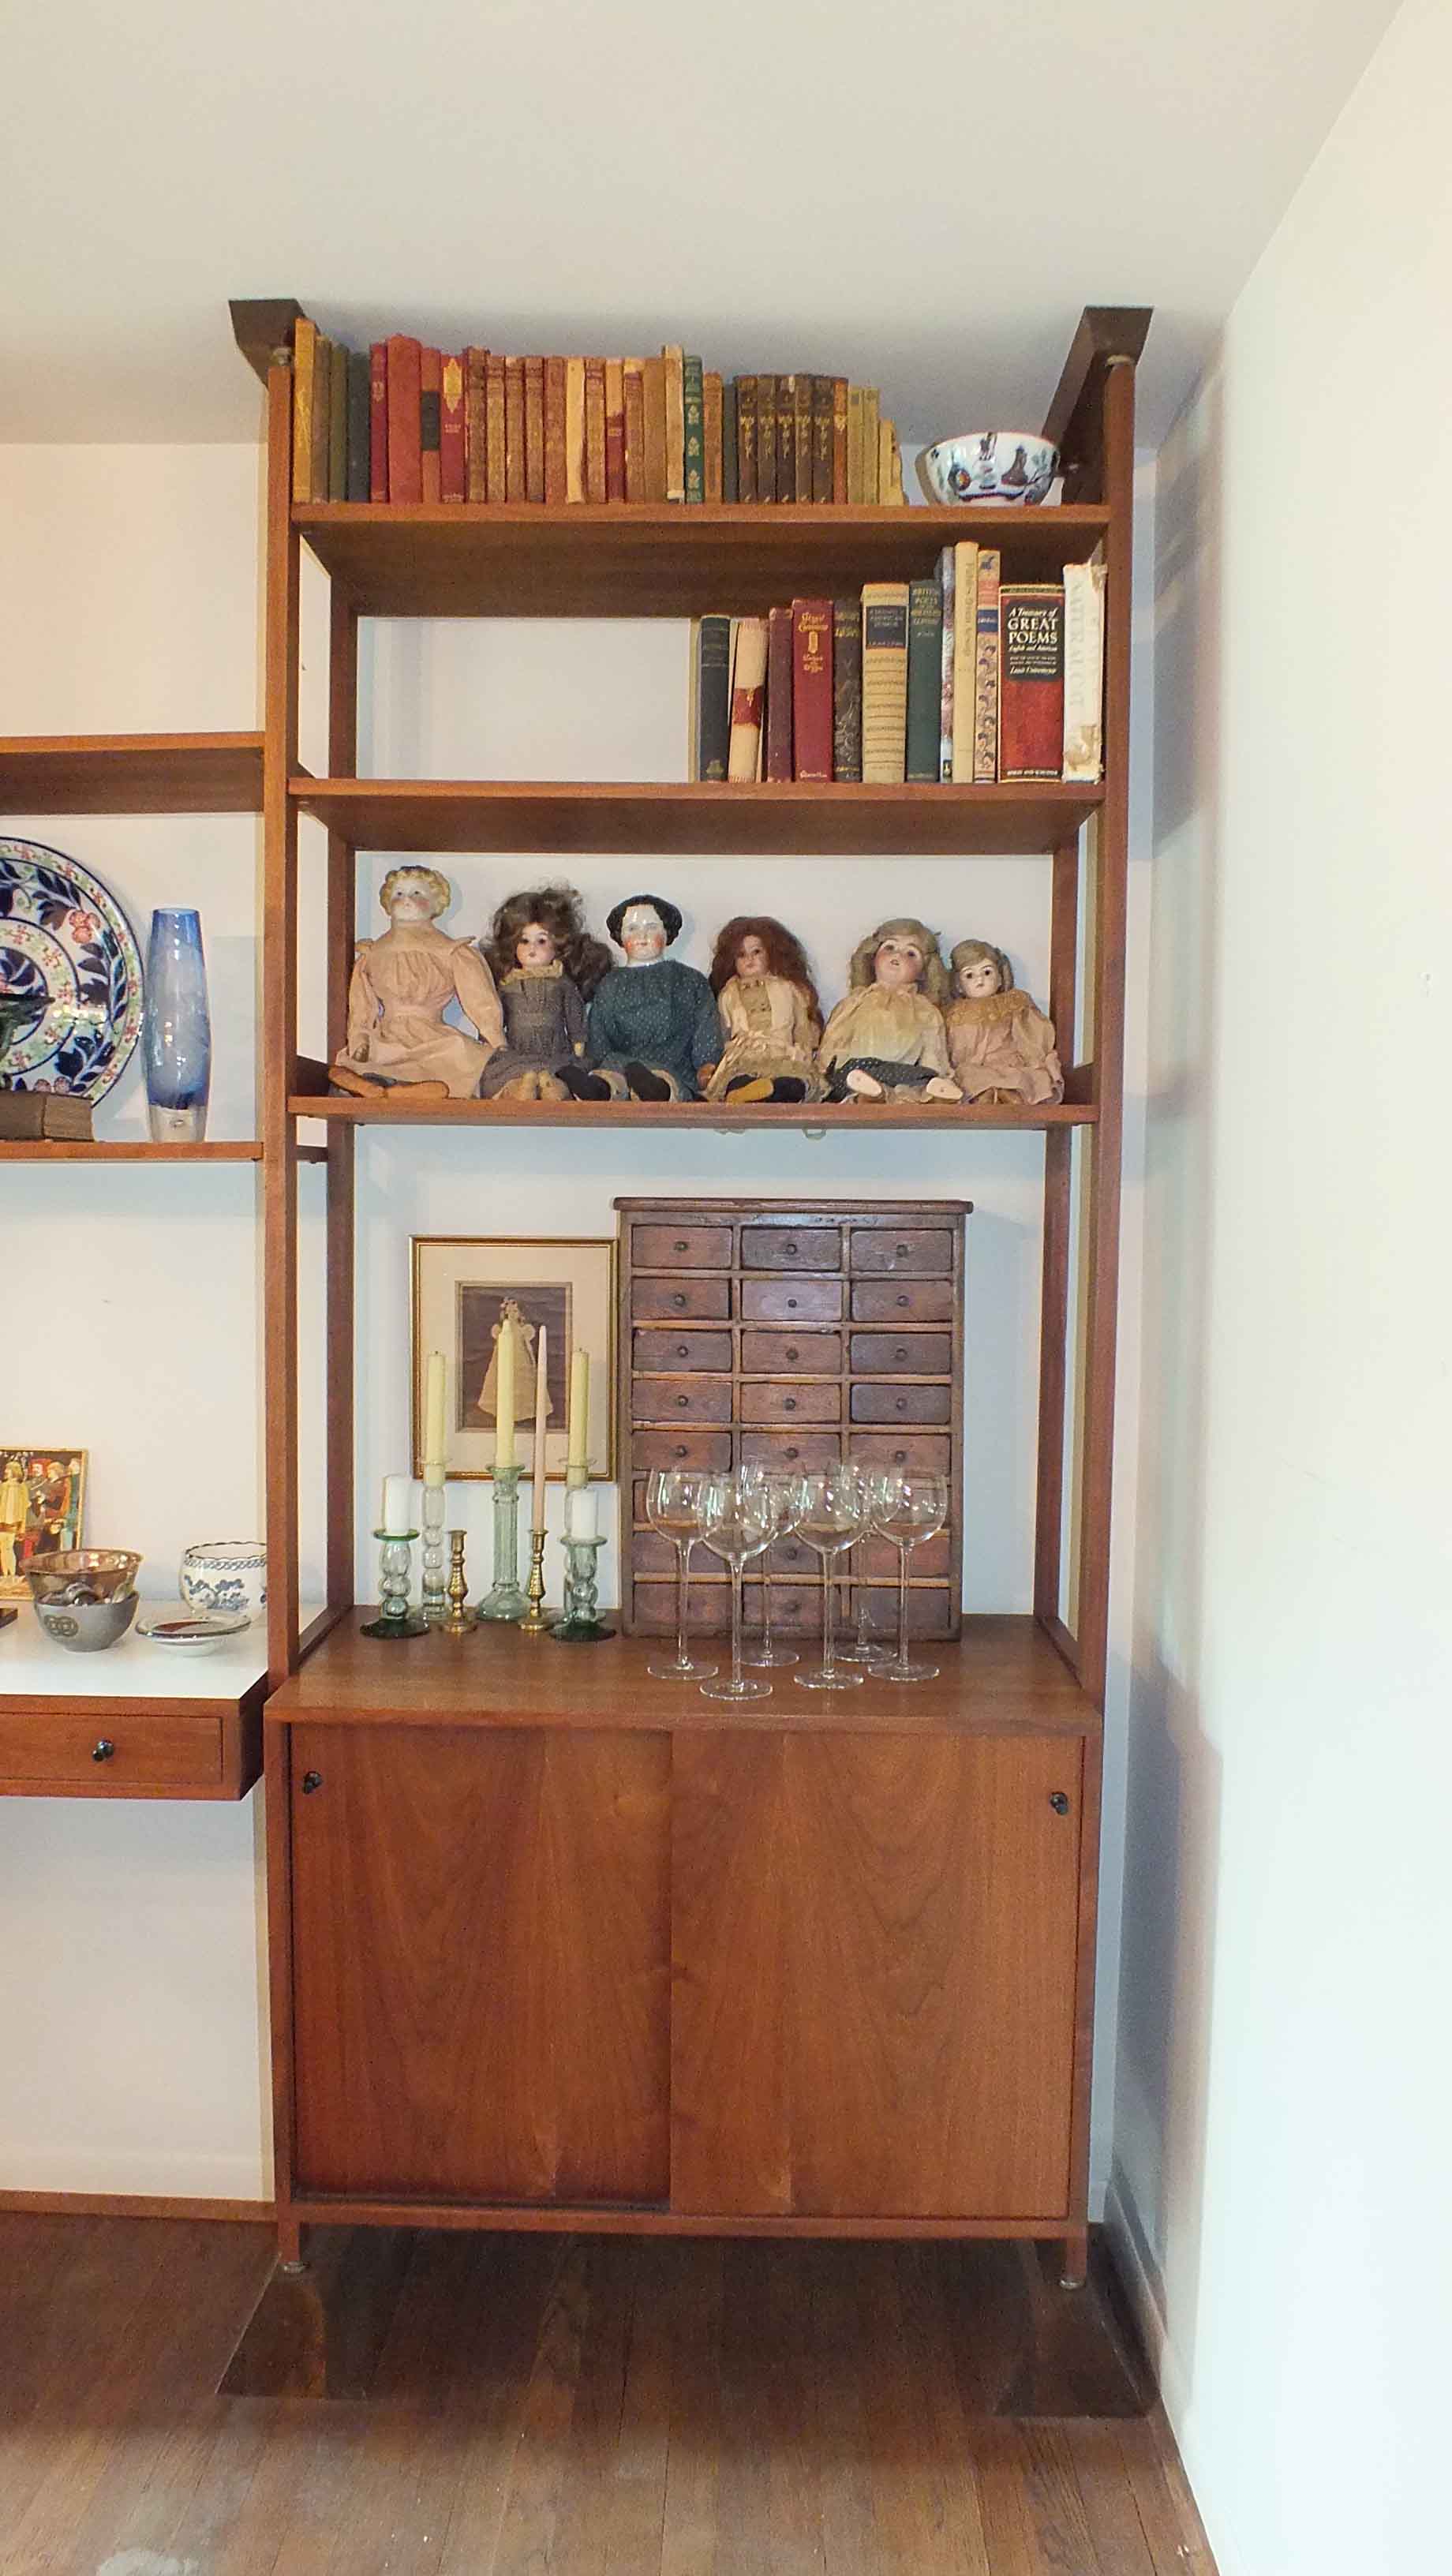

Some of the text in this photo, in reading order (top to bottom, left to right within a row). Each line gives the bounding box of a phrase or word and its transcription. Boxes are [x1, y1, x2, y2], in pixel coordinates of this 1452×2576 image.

[1009, 607, 1016, 617] A
[1047, 607, 1058, 621] of
[1008, 617, 1058, 631] GREAT
[1009, 631, 1057, 644] POEMS
